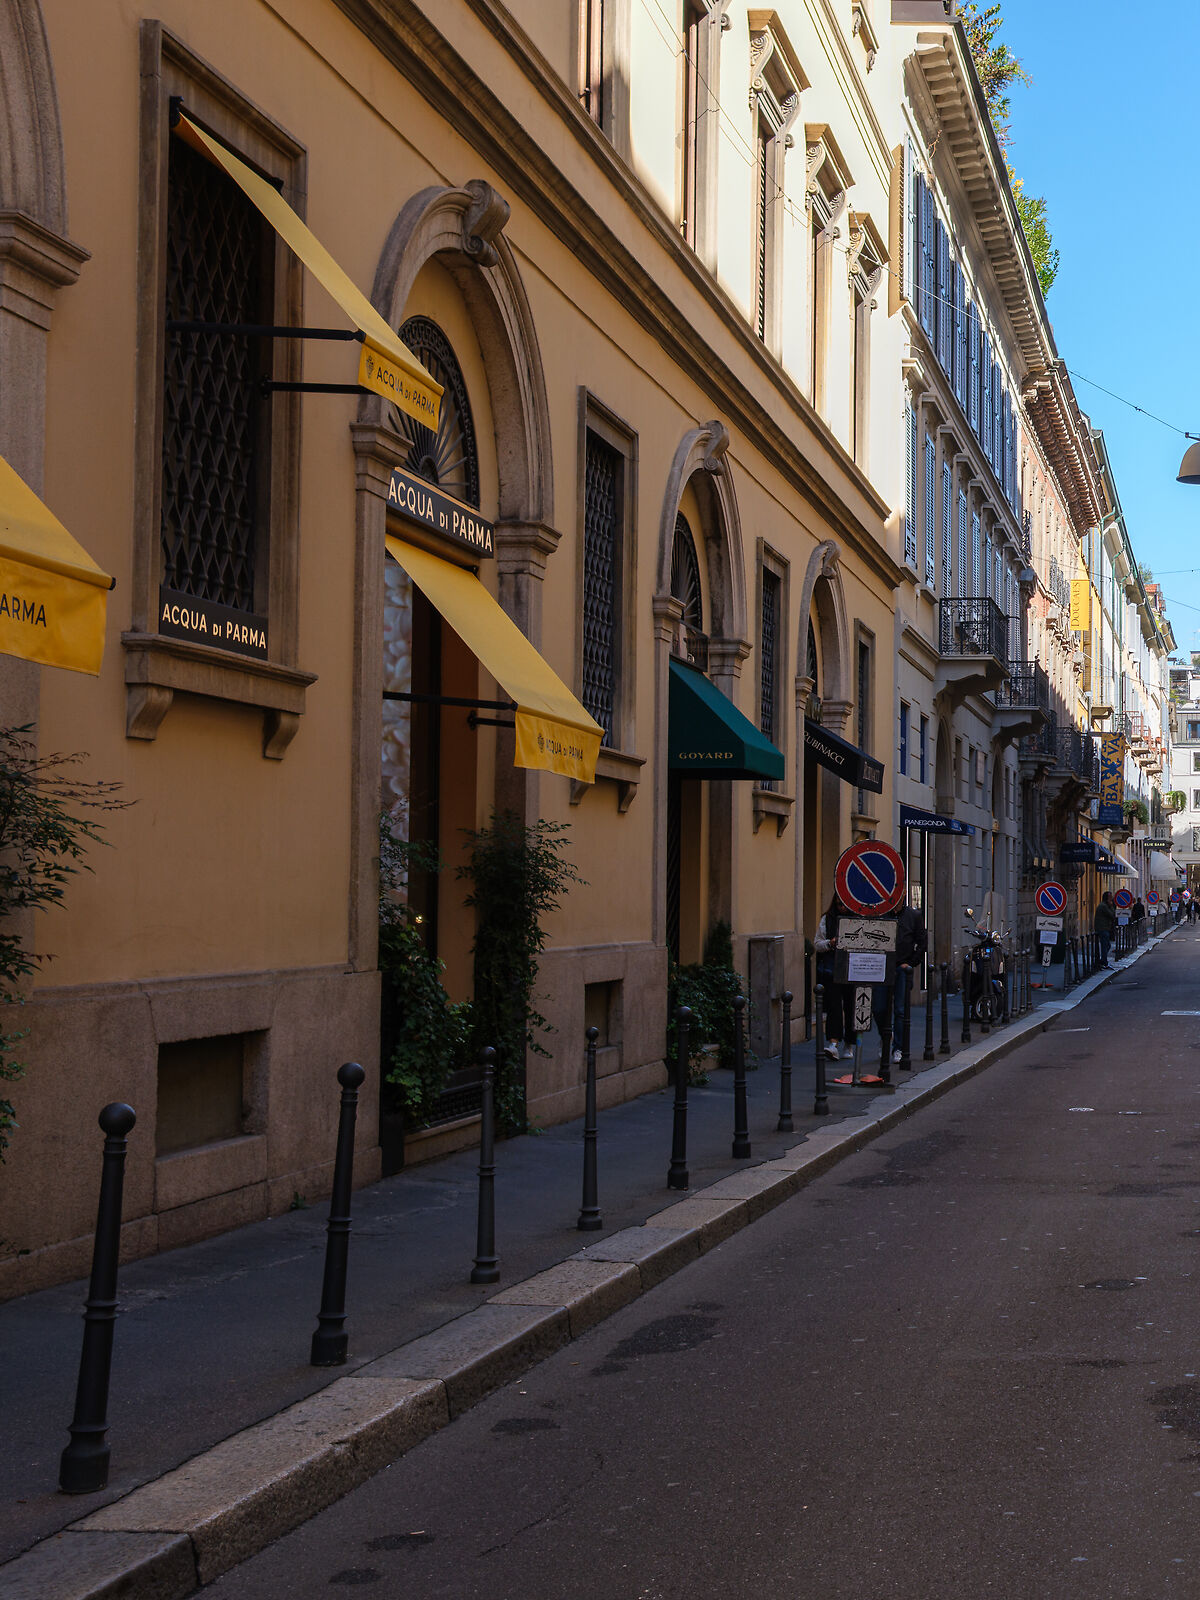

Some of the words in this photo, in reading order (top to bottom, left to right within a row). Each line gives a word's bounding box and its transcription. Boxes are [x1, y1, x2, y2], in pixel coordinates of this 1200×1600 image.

[376, 366, 404, 396] ACQUA
[412, 390, 435, 417] PARMA
[388, 476, 435, 523] ACQUA
[452, 510, 493, 552] PARMA
[0, 592, 47, 628] ARMA
[162, 603, 208, 633] ACQUA
[226, 621, 267, 649] PARMA
[678, 751, 734, 760] GOYARD
[904, 819, 947, 827] PIANEGONDA
